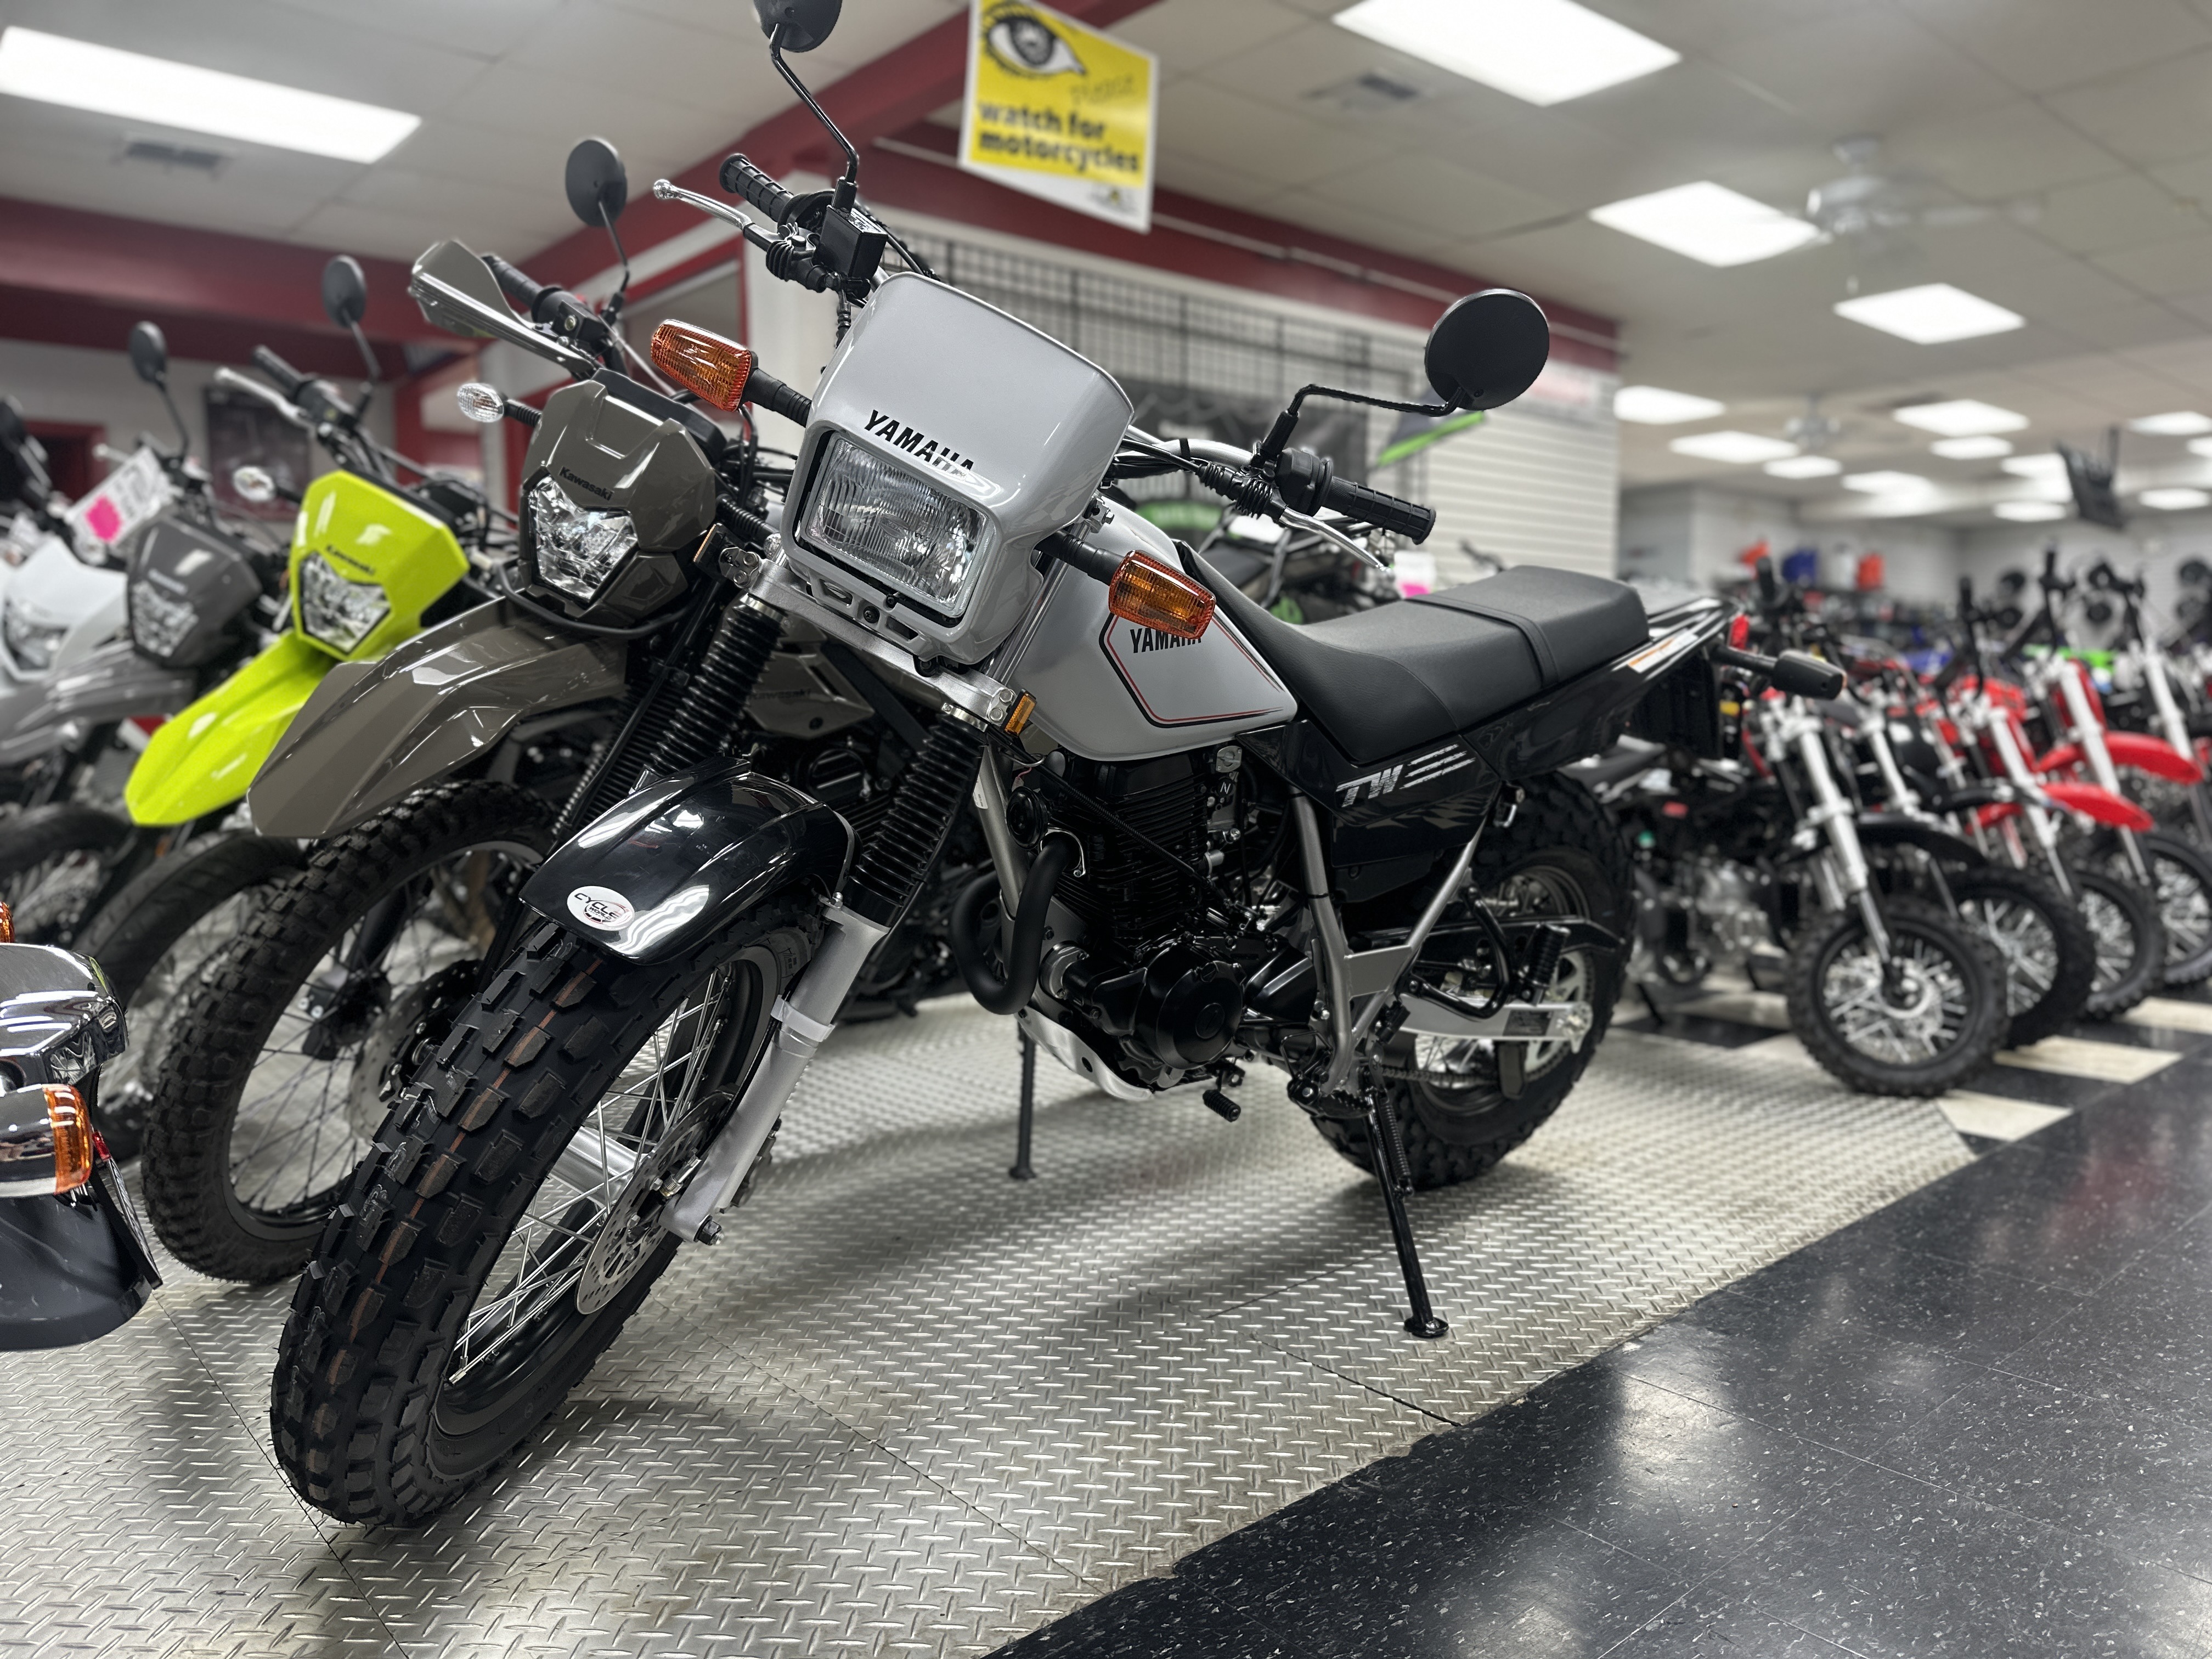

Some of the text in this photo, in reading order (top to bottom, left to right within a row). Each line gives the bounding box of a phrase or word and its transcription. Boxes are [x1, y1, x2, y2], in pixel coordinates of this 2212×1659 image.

[979, 103, 1105, 139] watch for
[980, 132, 1139, 172] motorcycles
[560, 466, 613, 500] Kawasaki
[574, 893, 620, 919] CYCLE
[589, 906, 612, 920] WORLD
